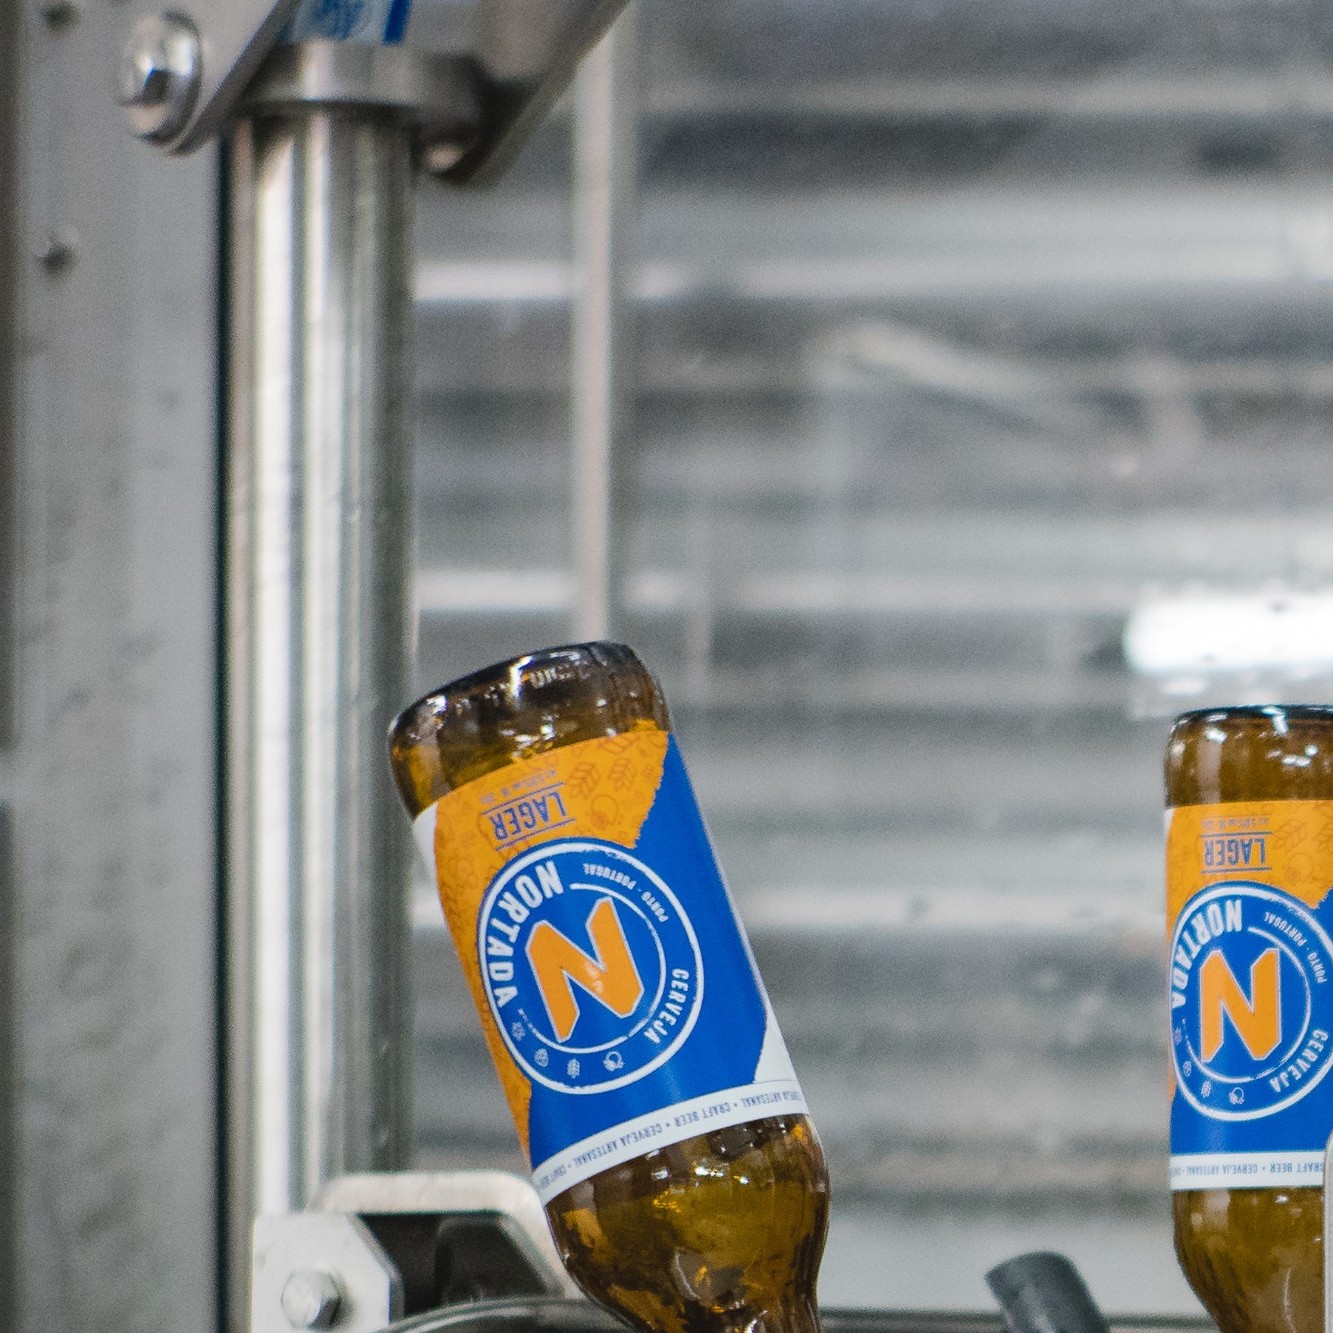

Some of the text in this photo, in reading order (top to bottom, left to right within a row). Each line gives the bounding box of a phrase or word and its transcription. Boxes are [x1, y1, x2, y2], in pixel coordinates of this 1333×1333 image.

[490, 792, 567, 841] LAGER
[1204, 838, 1267, 867] LAGER
[487, 860, 564, 1009] NORTADA
[1172, 899, 1243, 1009] NORTADA
[1263, 911, 1328, 984] PORTO PORTUGAL
[526, 895, 645, 1044] N
[643, 967, 690, 1045] CERVEJA
[1199, 947, 1282, 1062] N
[1268, 1029, 1329, 1093] CERVEJA
[674, 1111, 700, 1128] BEER
[701, 1102, 732, 1119] CRAFT
[572, 1140, 618, 1166] ARTESANAL
[619, 1123, 663, 1148] CERVEJA
[1221, 1163, 1258, 1175] CERVEJA
[1269, 1163, 1293, 1174] BEER
